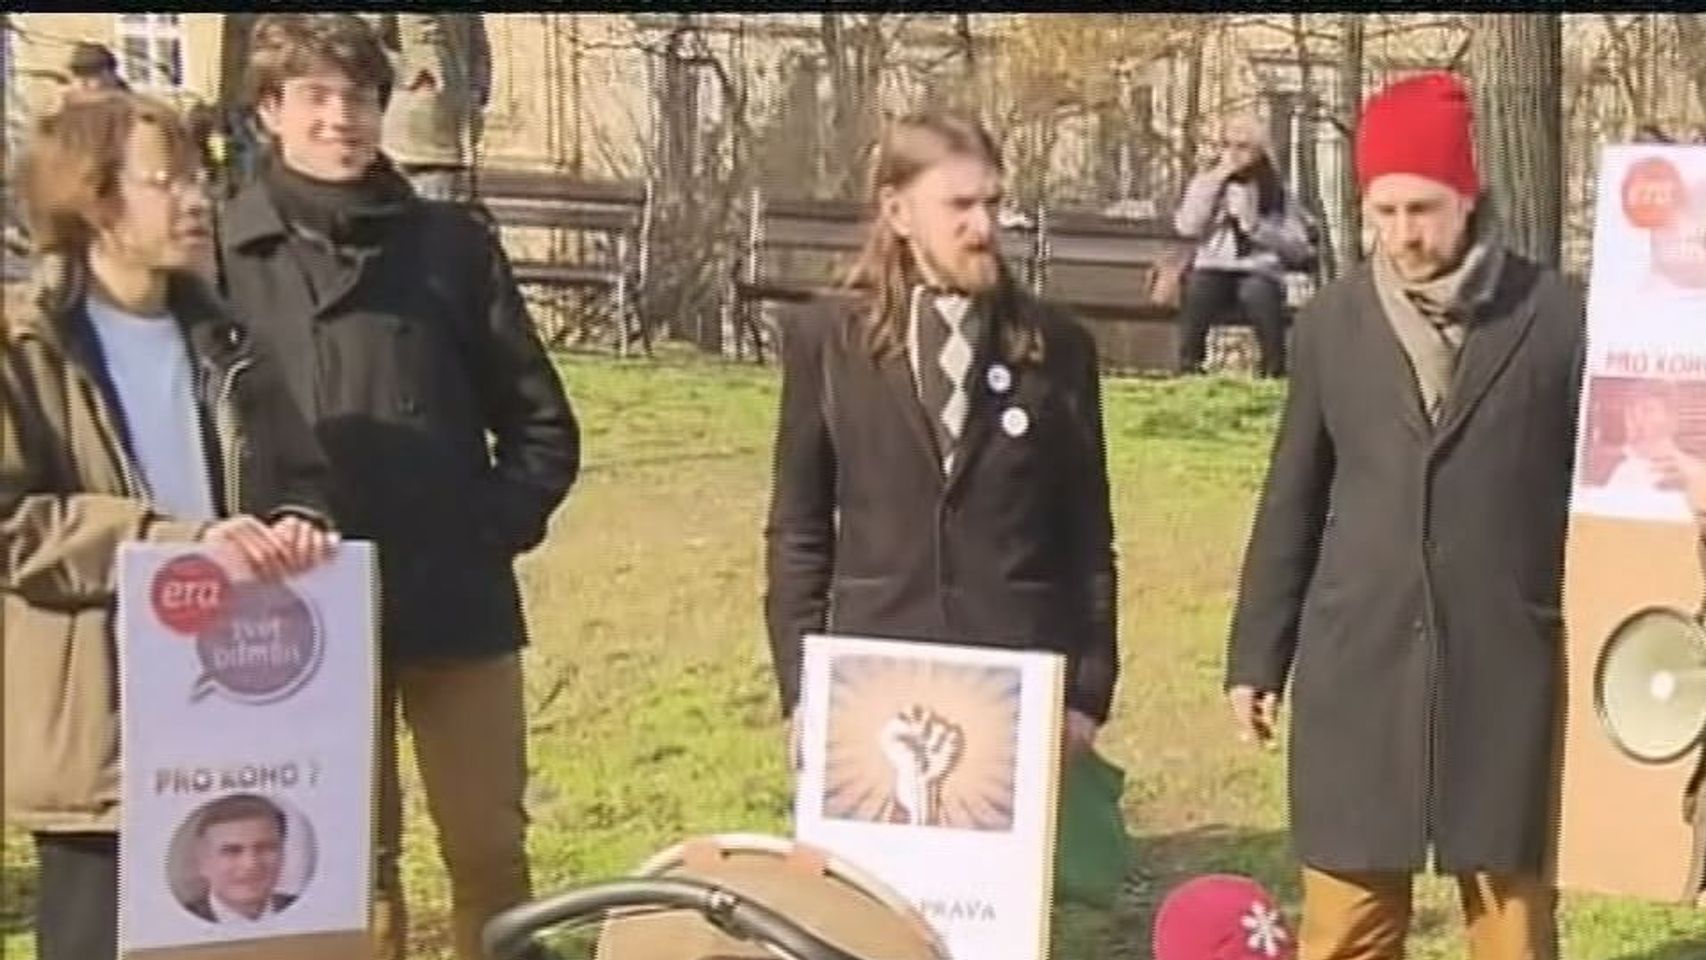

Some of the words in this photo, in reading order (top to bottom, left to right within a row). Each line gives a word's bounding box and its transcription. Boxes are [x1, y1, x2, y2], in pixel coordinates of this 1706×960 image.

[161, 580, 220, 609] era
[155, 766, 214, 795] PRO
[219, 762, 299, 790] KOHO
